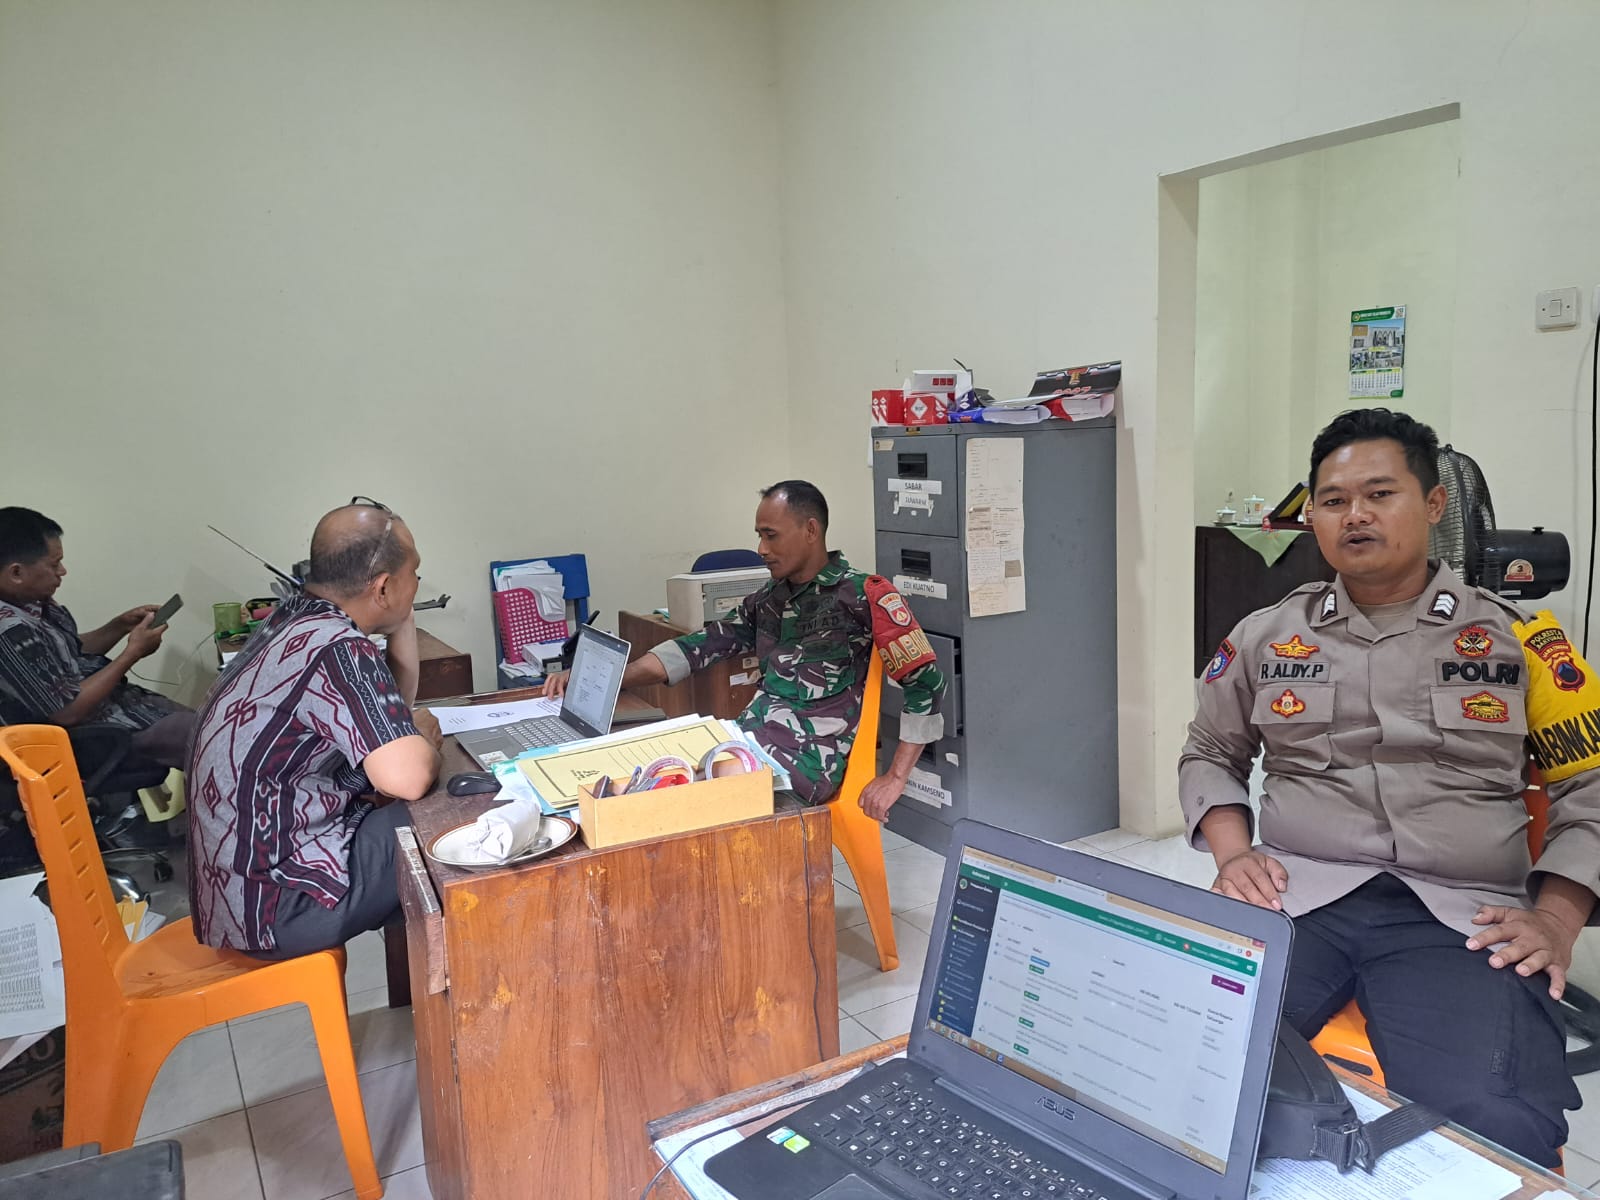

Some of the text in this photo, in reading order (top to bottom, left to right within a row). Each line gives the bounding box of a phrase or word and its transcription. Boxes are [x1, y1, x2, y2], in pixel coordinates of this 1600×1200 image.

[904, 481, 922, 490] SABAR
[1517, 565, 1523, 573] 3
[903, 581, 912, 589] EDI
[1261, 662, 1324, 680] R.ALDY.P
[1442, 661, 1520, 685] POLRI
[1525, 707, 1600, 770] ABINKA
[1035, 1095, 1076, 1121] ASUS
